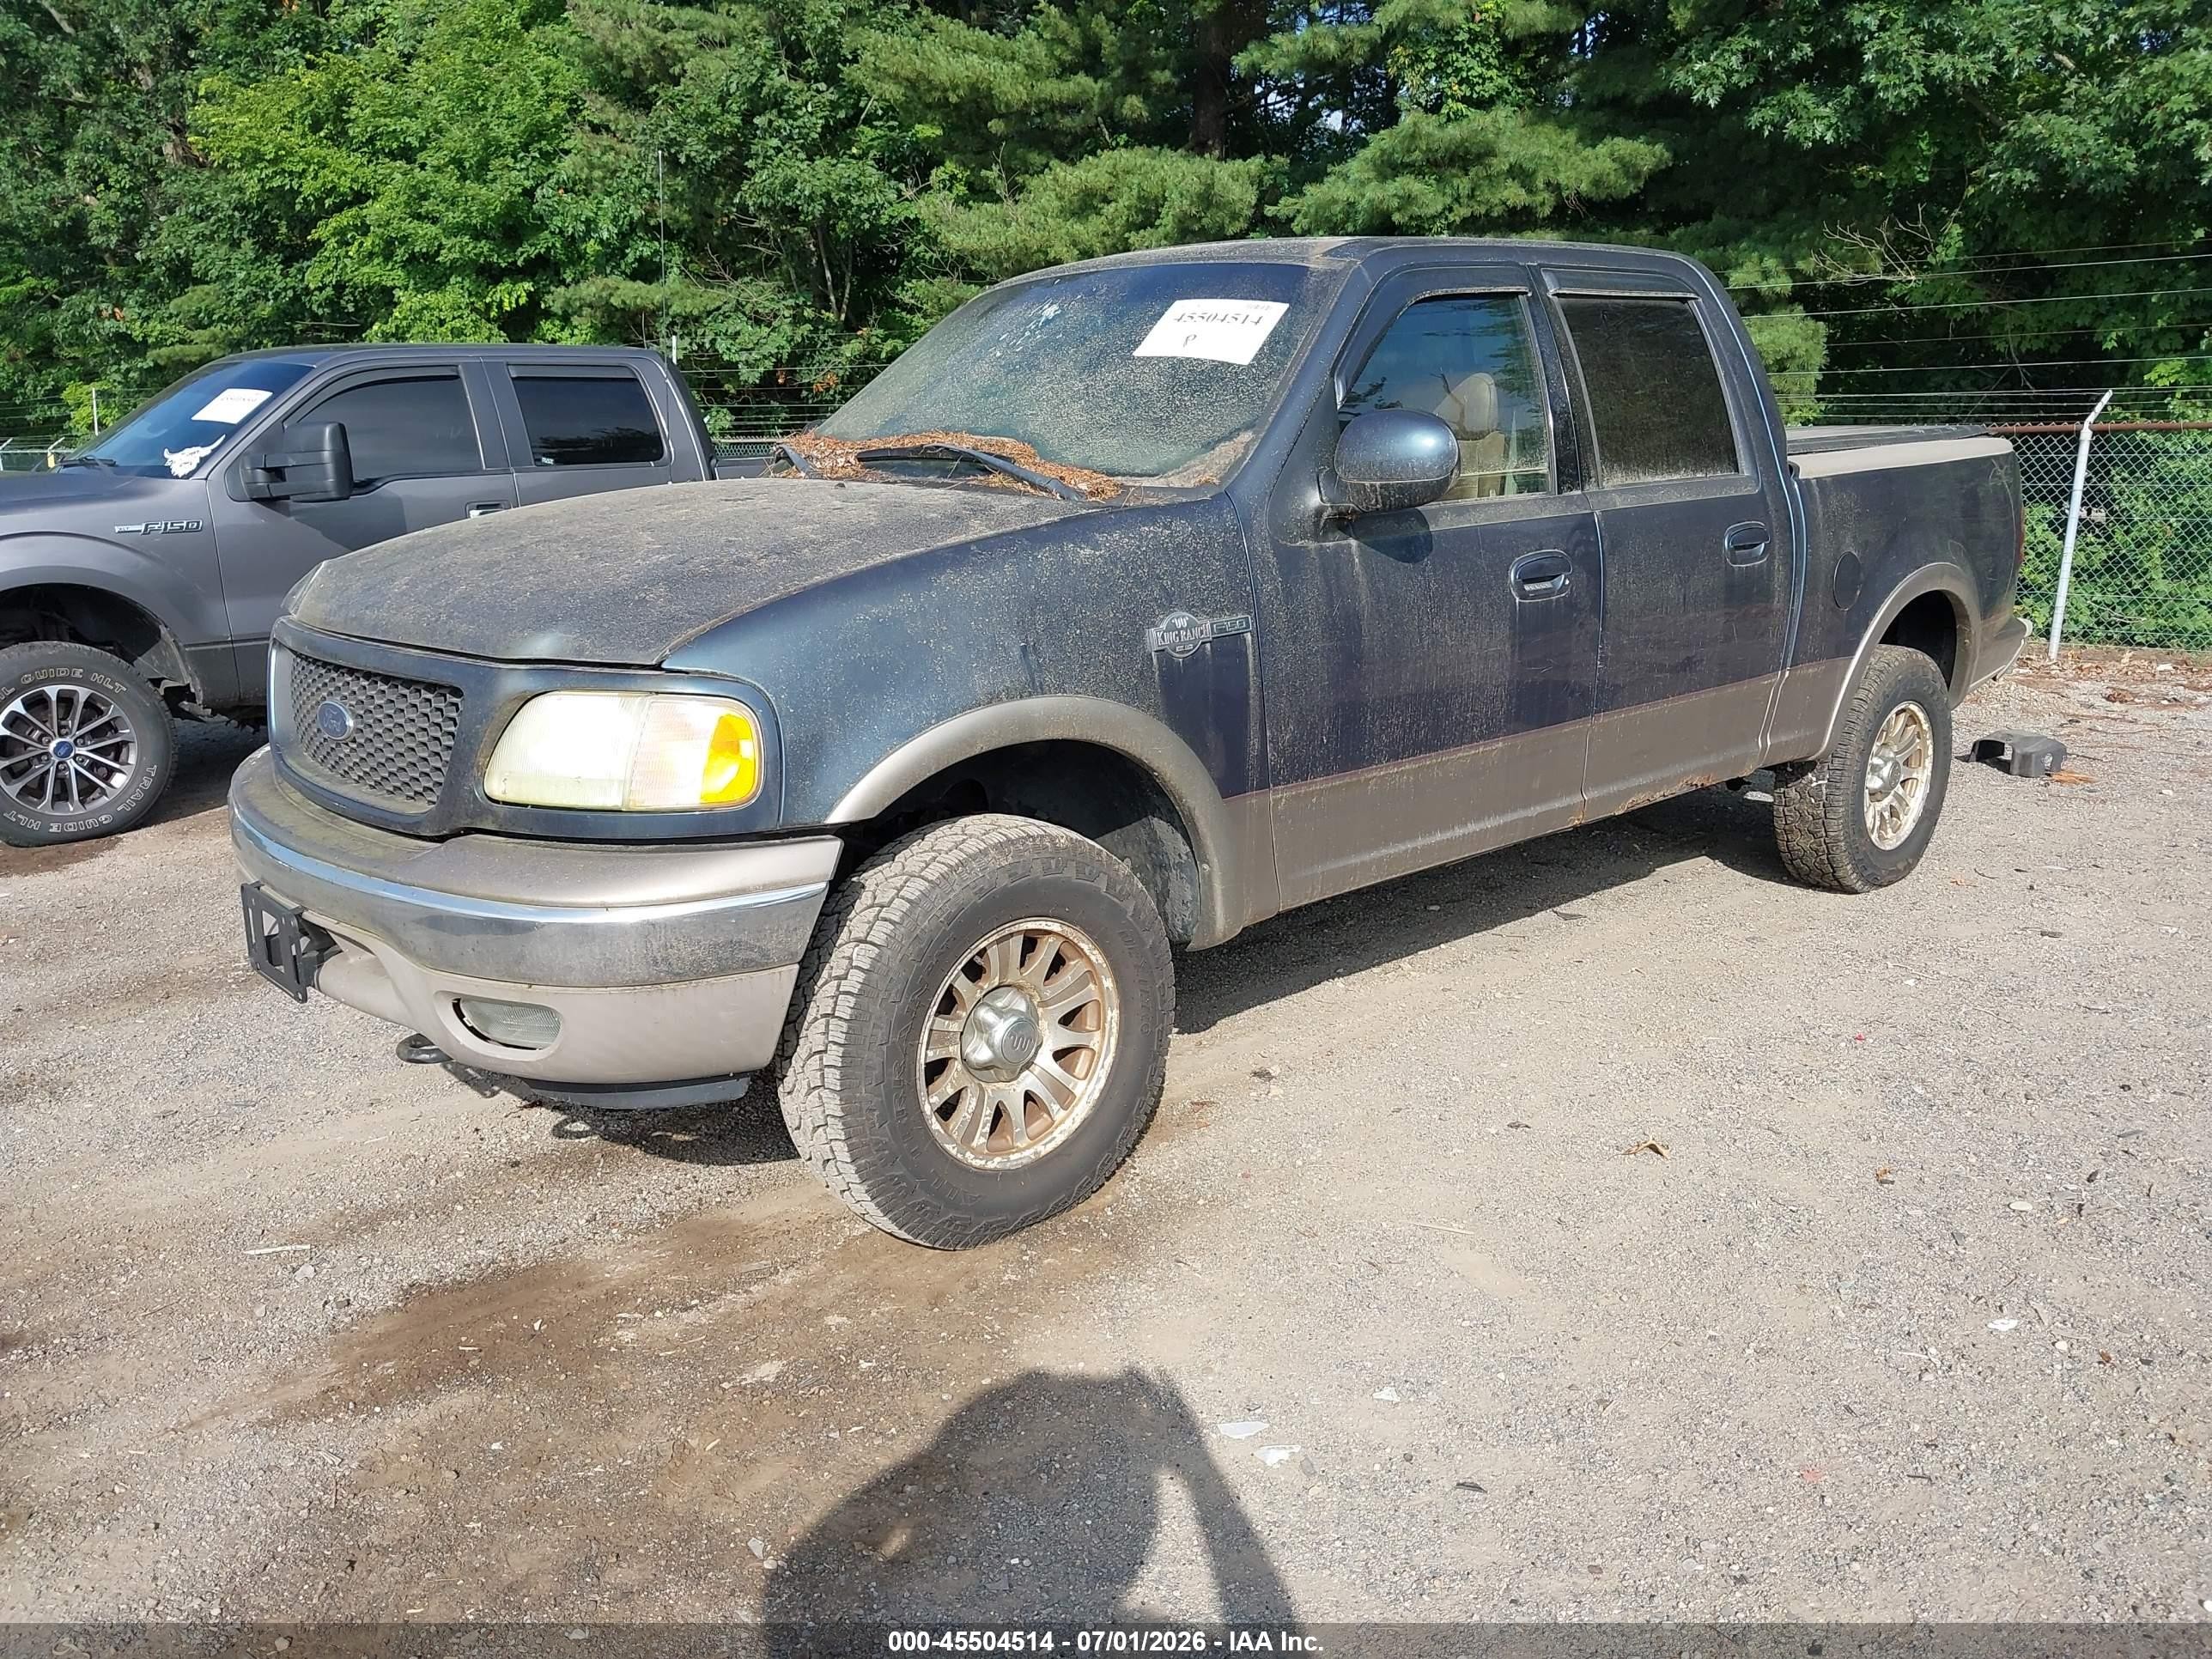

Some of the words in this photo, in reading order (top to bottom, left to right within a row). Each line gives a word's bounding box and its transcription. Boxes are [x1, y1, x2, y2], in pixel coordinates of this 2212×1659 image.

[1173, 313, 1263, 325] 45504514
[1157, 628, 1180, 646] KING
[1181, 623, 1210, 641] RANCH
[21, 668, 83, 684] GUIDE
[90, 672, 126, 693] HLT
[323, 708, 343, 732] Ford
[117, 765, 157, 811] TRAIL
[4, 811, 41, 830] HLT
[49, 814, 113, 832] GUIDE
